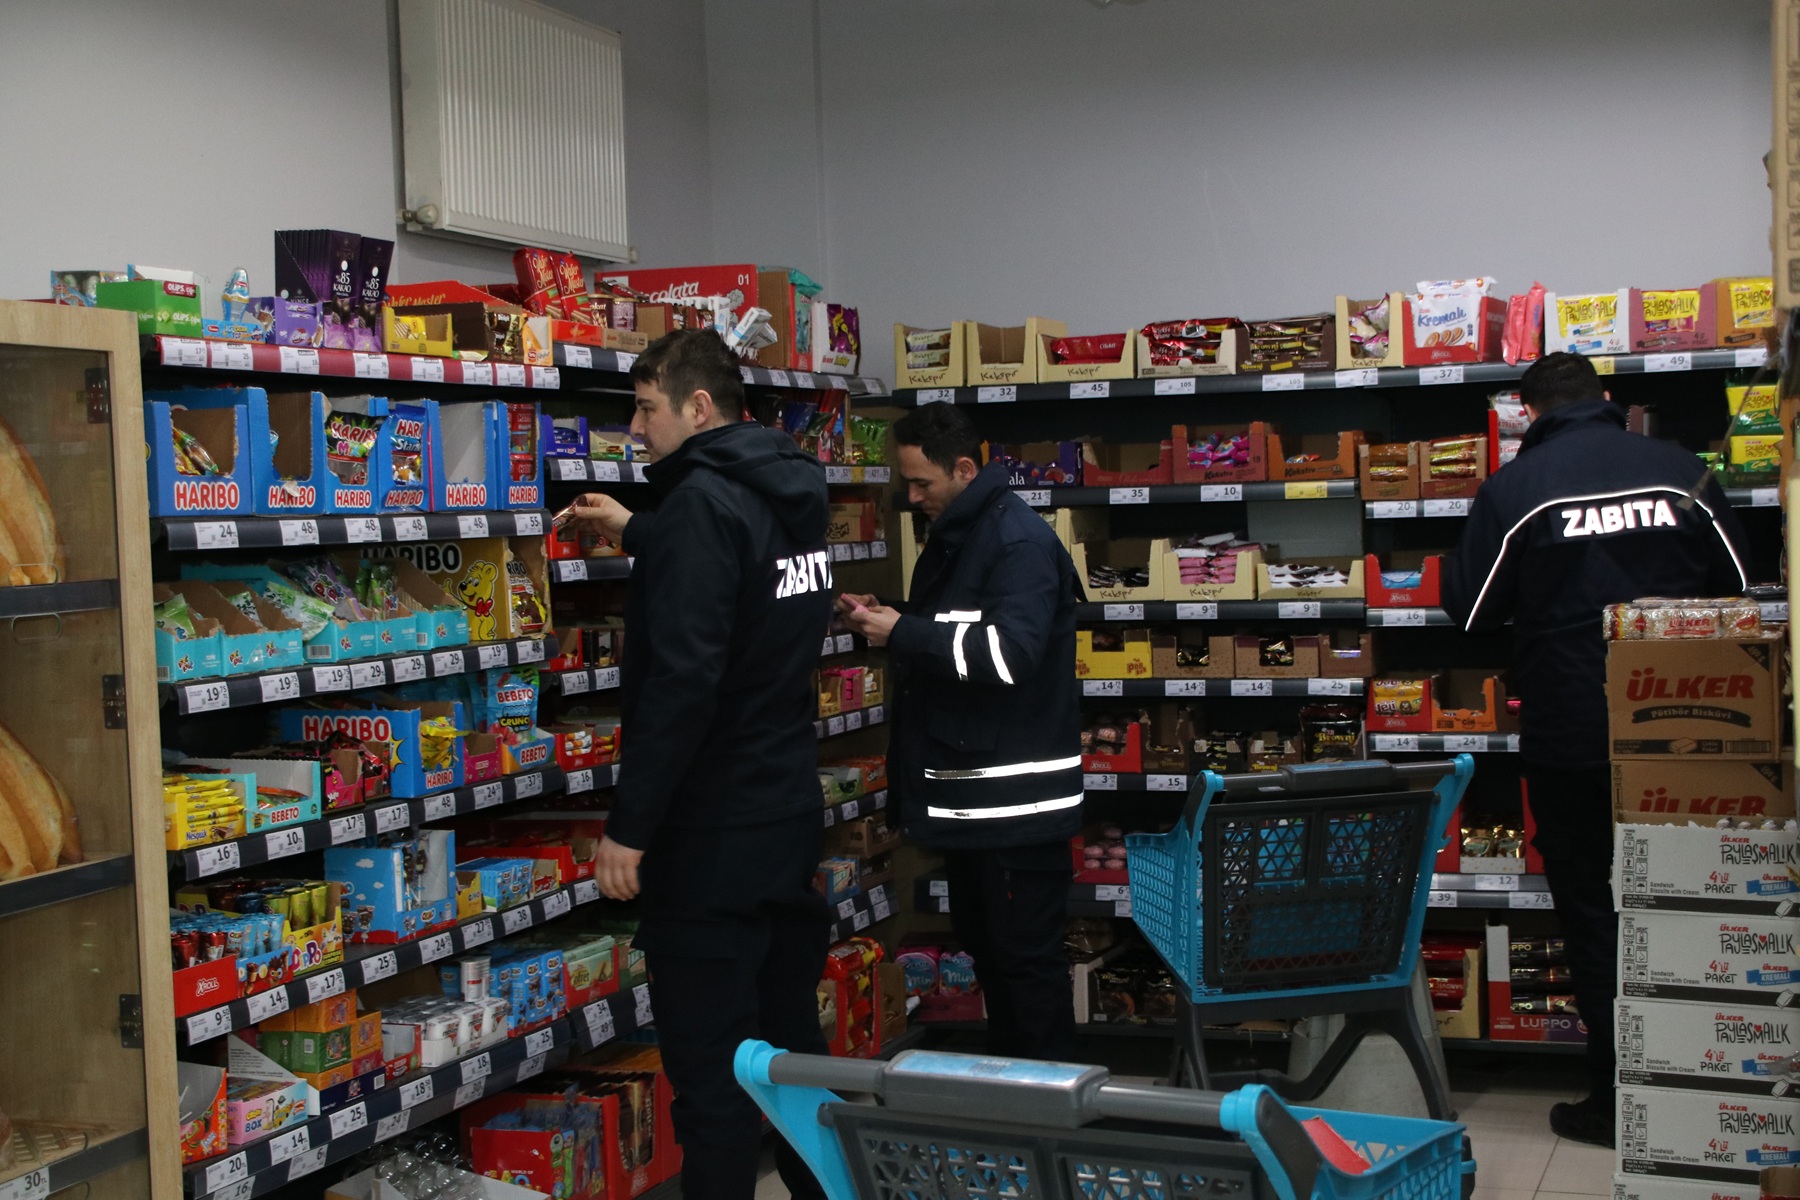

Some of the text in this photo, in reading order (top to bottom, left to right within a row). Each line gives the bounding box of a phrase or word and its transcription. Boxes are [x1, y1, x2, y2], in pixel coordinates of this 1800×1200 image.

[738, 274, 750, 286] 01
[333, 284, 352, 294] KAKAO
[362, 288, 380, 298] KAKAO
[1670, 356, 1684, 365] 49
[1362, 371, 1368, 380] 7
[1440, 370, 1452, 379] 37
[1000, 388, 1012, 396] 32
[1092, 384, 1104, 392] 45
[938, 390, 950, 398] 32
[573, 460, 582, 471] 25
[1284, 467, 1316, 478] Kekstra
[174, 481, 240, 510] HARIBO
[446, 483, 487, 508] HARIBO
[509, 486, 538, 504] HARIBO
[1031, 492, 1042, 500] 21
[1131, 490, 1144, 498] 35
[1224, 488, 1236, 496] 10
[335, 490, 372, 508] HARIBO
[386, 490, 424, 507] HARIBO
[1398, 502, 1410, 510] 20
[1449, 500, 1462, 509] 20
[412, 517, 422, 530] 48
[474, 518, 484, 529] 48
[530, 516, 540, 528] 55
[1561, 499, 1676, 538] ZABITA
[219, 525, 232, 538] 24
[302, 521, 312, 534] 48
[365, 520, 376, 532] 48
[572, 562, 580, 572] 18
[1129, 606, 1134, 614] 9
[1202, 606, 1208, 614] 9
[1304, 604, 1309, 612] 9
[1775, 604, 1788, 613] 14
[1406, 612, 1419, 620] 16
[1670, 618, 1710, 628] ÜLKER
[493, 646, 501, 657] 19
[532, 642, 540, 653] 48
[412, 658, 422, 670] 29
[450, 653, 460, 665] 29
[332, 669, 343, 682] 19
[371, 664, 380, 677] 29
[577, 674, 585, 684] 11
[608, 672, 615, 682] 16
[279, 677, 290, 690] 19
[1185, 682, 1196, 690] 14
[1252, 682, 1263, 690] 14
[1626, 667, 1754, 702] ÜLKER
[207, 688, 219, 701] 19
[496, 688, 534, 703] BEBETO
[1652, 708, 1731, 720] Pötibör Bisküvi
[303, 716, 390, 742] HARIBO
[1315, 732, 1356, 742] Browni
[1397, 738, 1410, 746] 14
[1463, 738, 1476, 746] 24
[520, 745, 547, 766] BEBETO
[426, 769, 454, 790] HARIBO
[528, 776, 536, 788] 37
[582, 772, 590, 783] 16
[1102, 776, 1108, 784] 3
[1168, 778, 1180, 786] 15
[487, 787, 496, 799] 24
[442, 796, 450, 809] 48
[271, 807, 300, 824] BEBETO
[392, 808, 400, 820] 17
[346, 818, 356, 830] 17
[186, 830, 208, 841] Nesquik
[286, 832, 298, 845] 10
[1720, 835, 1750, 844] ÜLKER
[217, 848, 230, 861] 16
[1762, 874, 1789, 882] ÜLKER
[1118, 886, 1124, 894] 6
[1438, 894, 1450, 902] 39
[1535, 894, 1548, 904] 78
[518, 910, 528, 922] 38
[476, 920, 484, 934] 27
[1720, 924, 1749, 933] ÜLKER
[436, 938, 446, 952] 24
[379, 956, 390, 970] 25
[1762, 962, 1788, 971] ÜLKER
[326, 975, 336, 989] 17
[270, 990, 282, 1006] 14
[599, 1002, 608, 1012] 34
[216, 1012, 222, 1026] 9
[1716, 1013, 1744, 1022] ÜLKER
[1520, 1018, 1570, 1029] LUPPO
[541, 1032, 550, 1044] 25
[478, 1056, 488, 1069] 18
[415, 1082, 426, 1096] 18
[1720, 1103, 1748, 1112] ÜLKER
[350, 1108, 361, 1122] 25
[246, 1118, 262, 1133] BOX
[292, 1133, 304, 1148] 14
[1762, 1141, 1788, 1150] ÜLKER
[230, 1158, 242, 1173] 20
[24, 1172, 40, 1190] 30
[236, 1184, 248, 1197] 16
